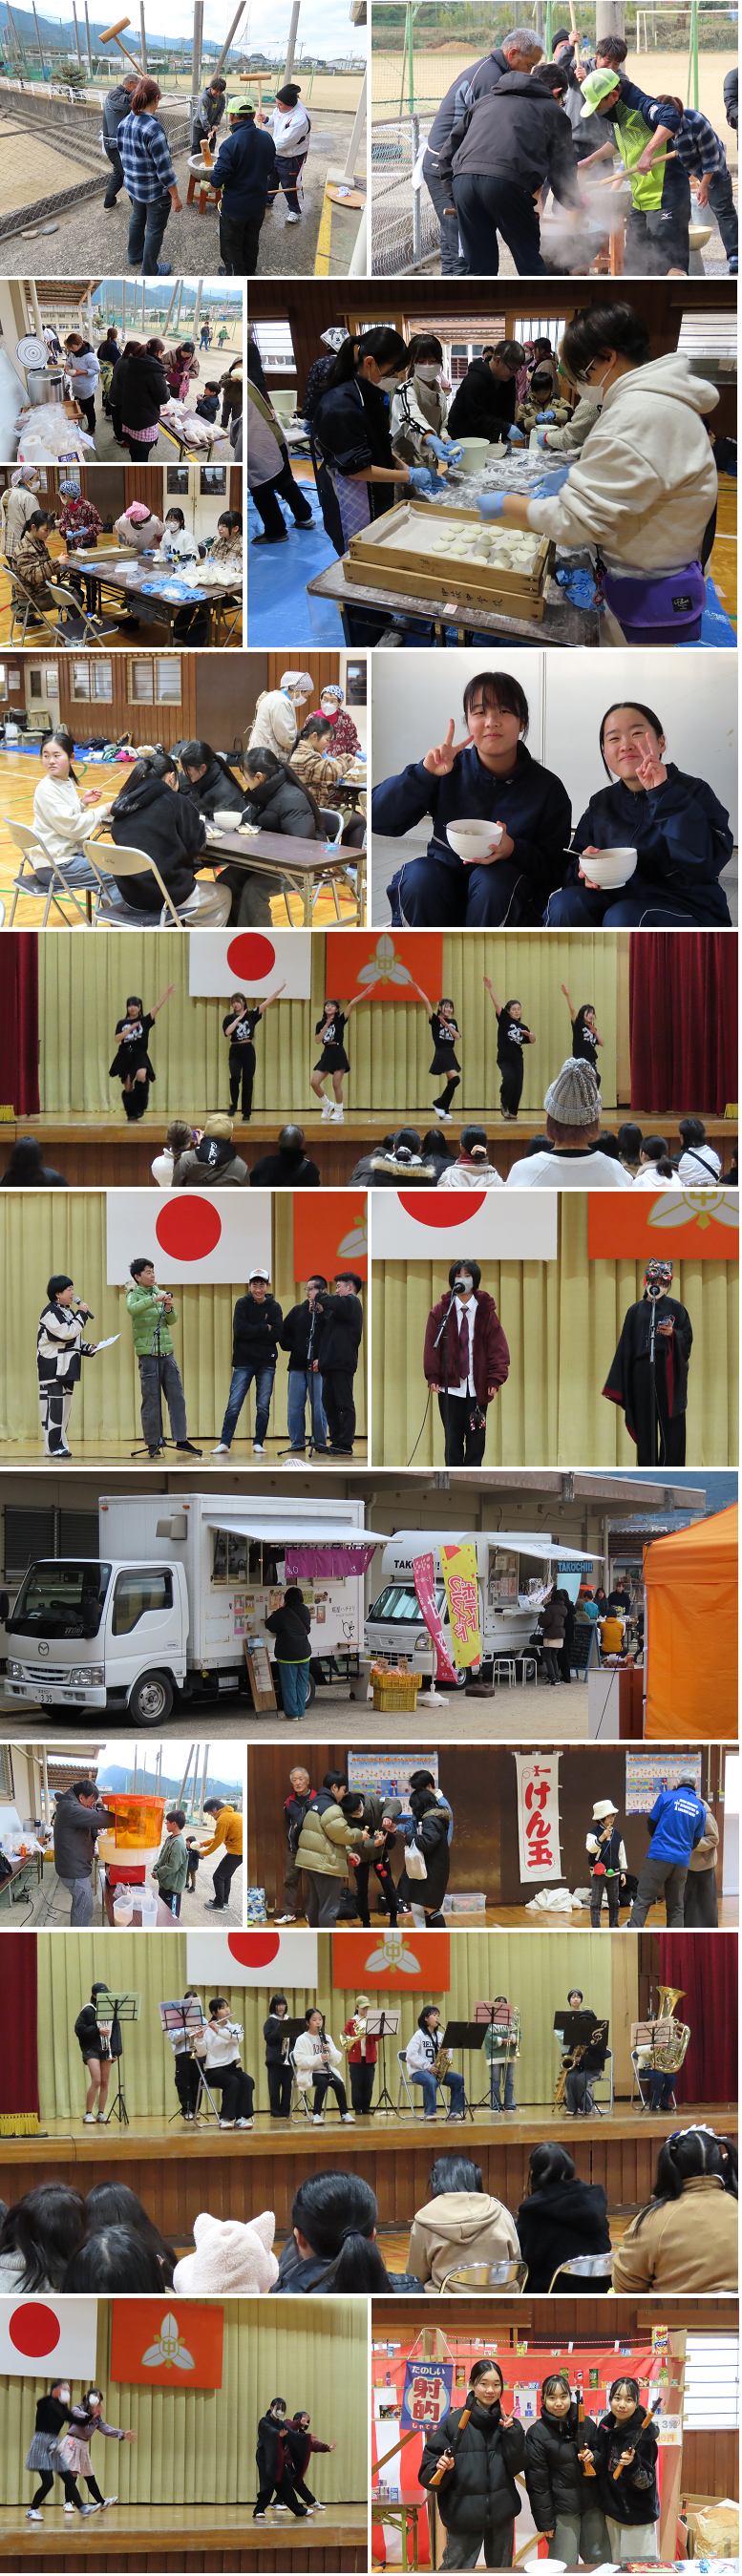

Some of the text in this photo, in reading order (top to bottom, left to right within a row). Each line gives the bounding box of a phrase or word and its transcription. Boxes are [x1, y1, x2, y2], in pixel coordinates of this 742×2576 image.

[525, 1782, 553, 1868] けん玉
[426, 2049, 435, 2064] 9
[162, 2339, 176, 2356] 中
[412, 2366, 445, 2375] たのしい
[412, 2376, 443, 2422] 射的
[412, 2421, 439, 2431] しゃてき
